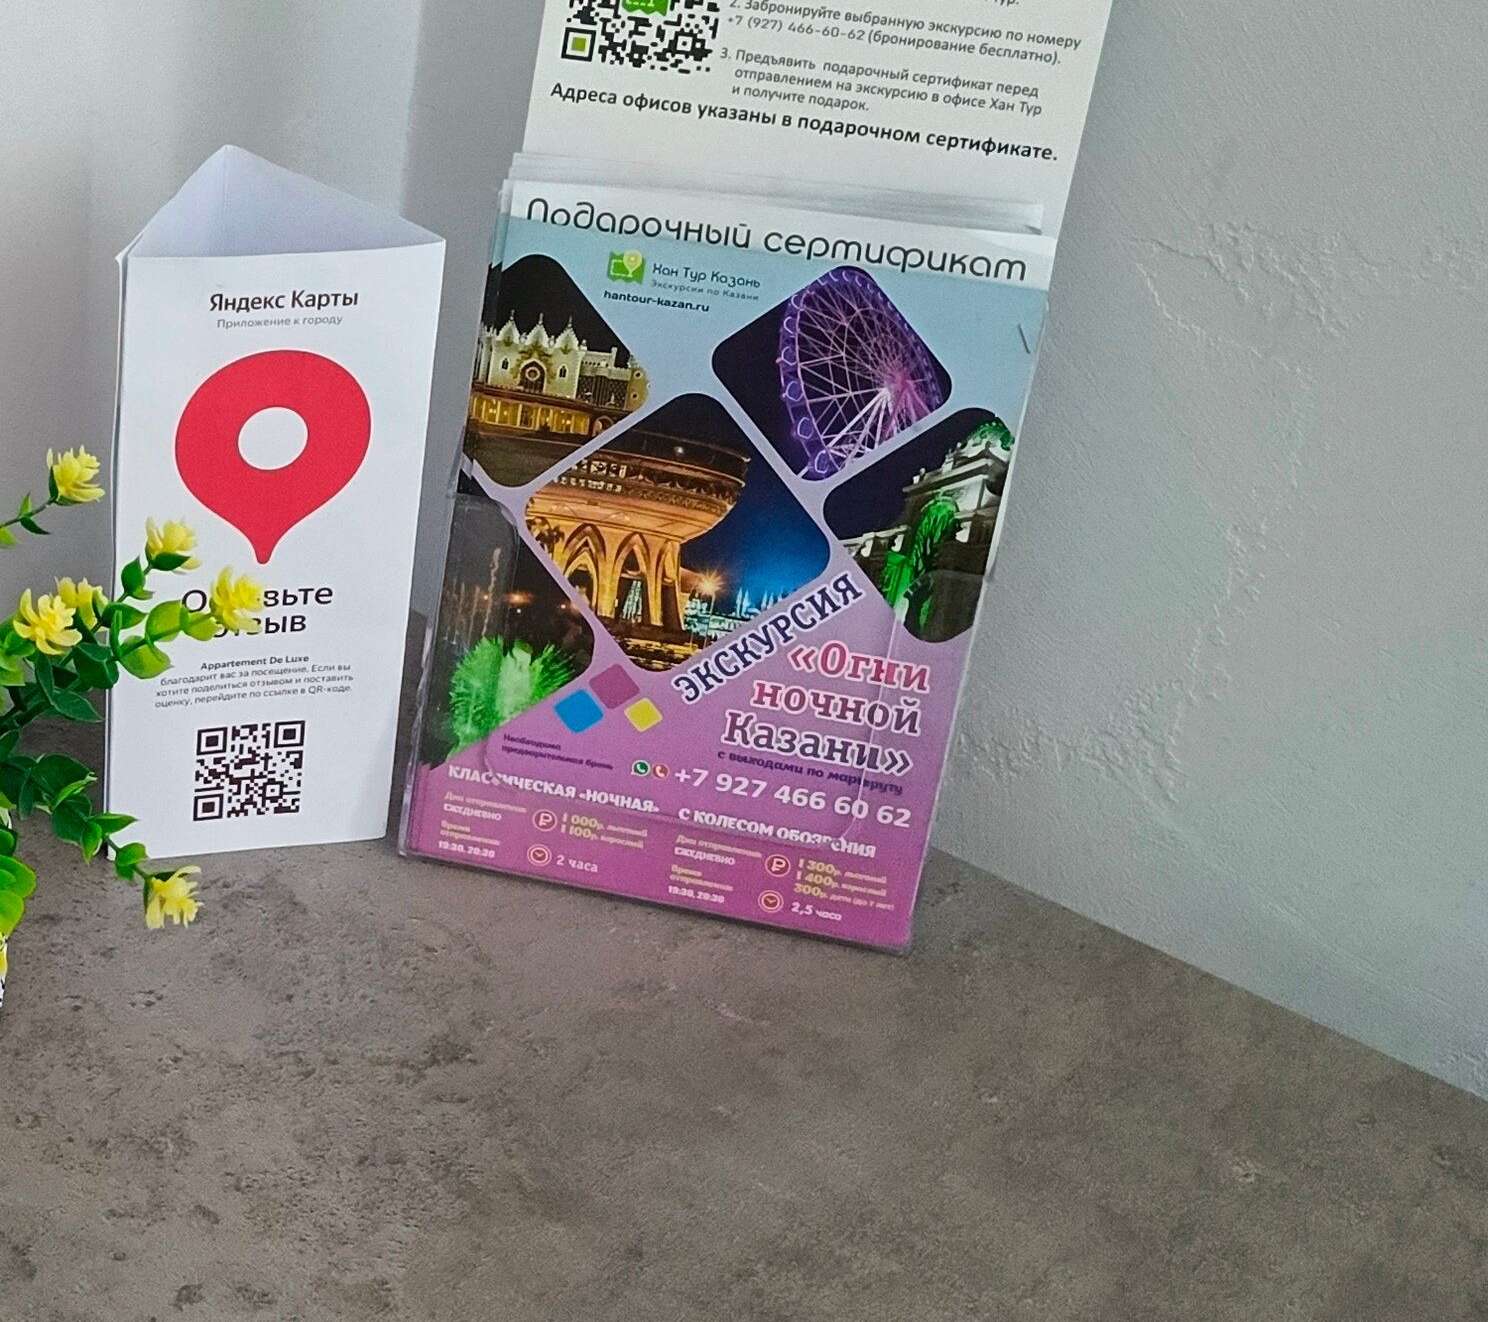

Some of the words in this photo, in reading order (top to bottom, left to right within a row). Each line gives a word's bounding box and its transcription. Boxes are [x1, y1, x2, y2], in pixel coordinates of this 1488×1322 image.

[727, 14, 743, 25] +7
[747, 16, 782, 32] (927)
[787, 21, 865, 40] 466-60-62
[867, 29, 975, 53] (бронирование
[978, 42, 1061, 65] бесплатно).
[844, 10, 925, 30] выбранную
[927, 21, 1002, 38] экскурсию
[1005, 30, 1023, 41] по
[1026, 33, 1081, 50] номеру
[549, 82, 617, 104] Адреса
[622, 92, 691, 114] офисов
[697, 103, 776, 124] указаны
[781, 114, 792, 127] в
[797, 116, 920, 143] подарочном
[925, 133, 1057, 161] сертификате.
[763, 231, 1026, 281] сертификат
[652, 262, 678, 276] Хан
[683, 266, 707, 282] Тур
[710, 270, 760, 288] Казань
[209, 293, 285, 313] Яндекс
[291, 289, 358, 310] Карты
[603, 289, 709, 312] hantour-kazan.ru
[216, 318, 290, 329] Приложение
[302, 316, 342, 325] городу
[672, 571, 863, 705] ЭКСКУРСИЯ
[199, 658, 266, 670] Appartement
[269, 656, 283, 664] De
[285, 655, 309, 663] Luxe
[787, 640, 931, 694] «Огни
[194, 692, 247, 703] перейдите
[262, 688, 298, 697] ссылке
[751, 678, 922, 736] ночной
[723, 711, 913, 776] Казани»
[674, 768, 708, 786] +7
[715, 773, 767, 797] 927
[773, 785, 826, 809] 466
[834, 794, 868, 820] 60
[876, 805, 911, 827] 62
[693, 810, 774, 836] КОЛЕСОМ
[556, 854, 564, 865] 2
[568, 858, 598, 872] часа
[791, 901, 813, 915] 2,5
